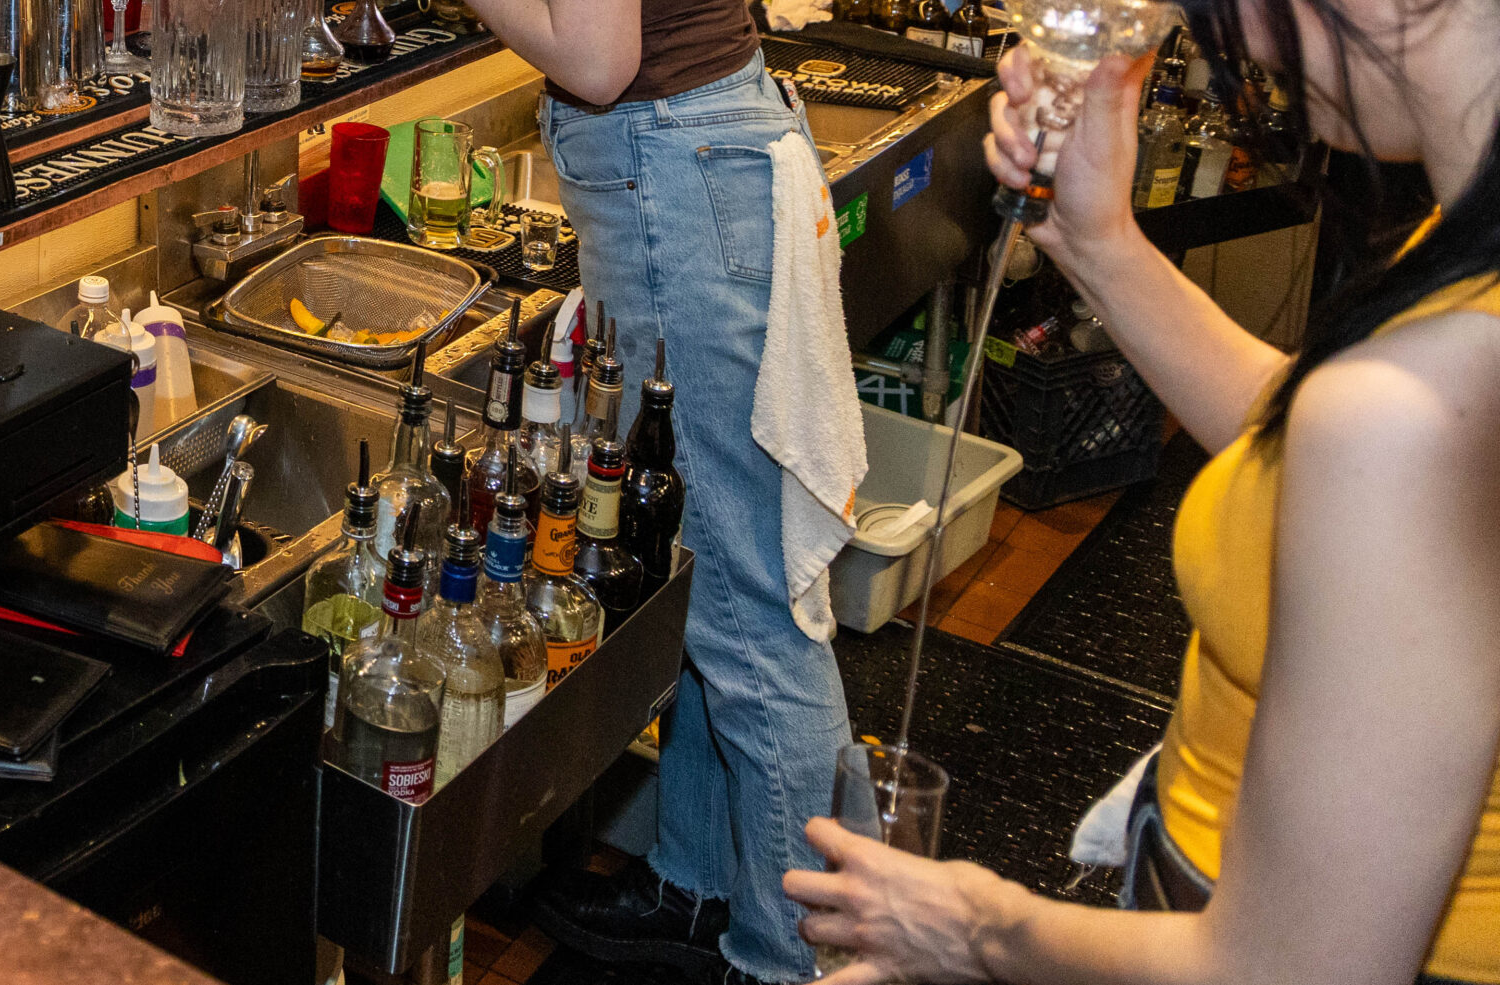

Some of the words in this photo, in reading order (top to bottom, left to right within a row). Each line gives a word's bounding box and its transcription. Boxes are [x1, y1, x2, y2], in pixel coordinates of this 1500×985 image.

[582, 498, 598, 515] YE
[118, 561, 156, 592] Thank
[151, 572, 180, 595] You
[570, 649, 591, 663] OLD
[389, 767, 431, 787] SOBIESKI
